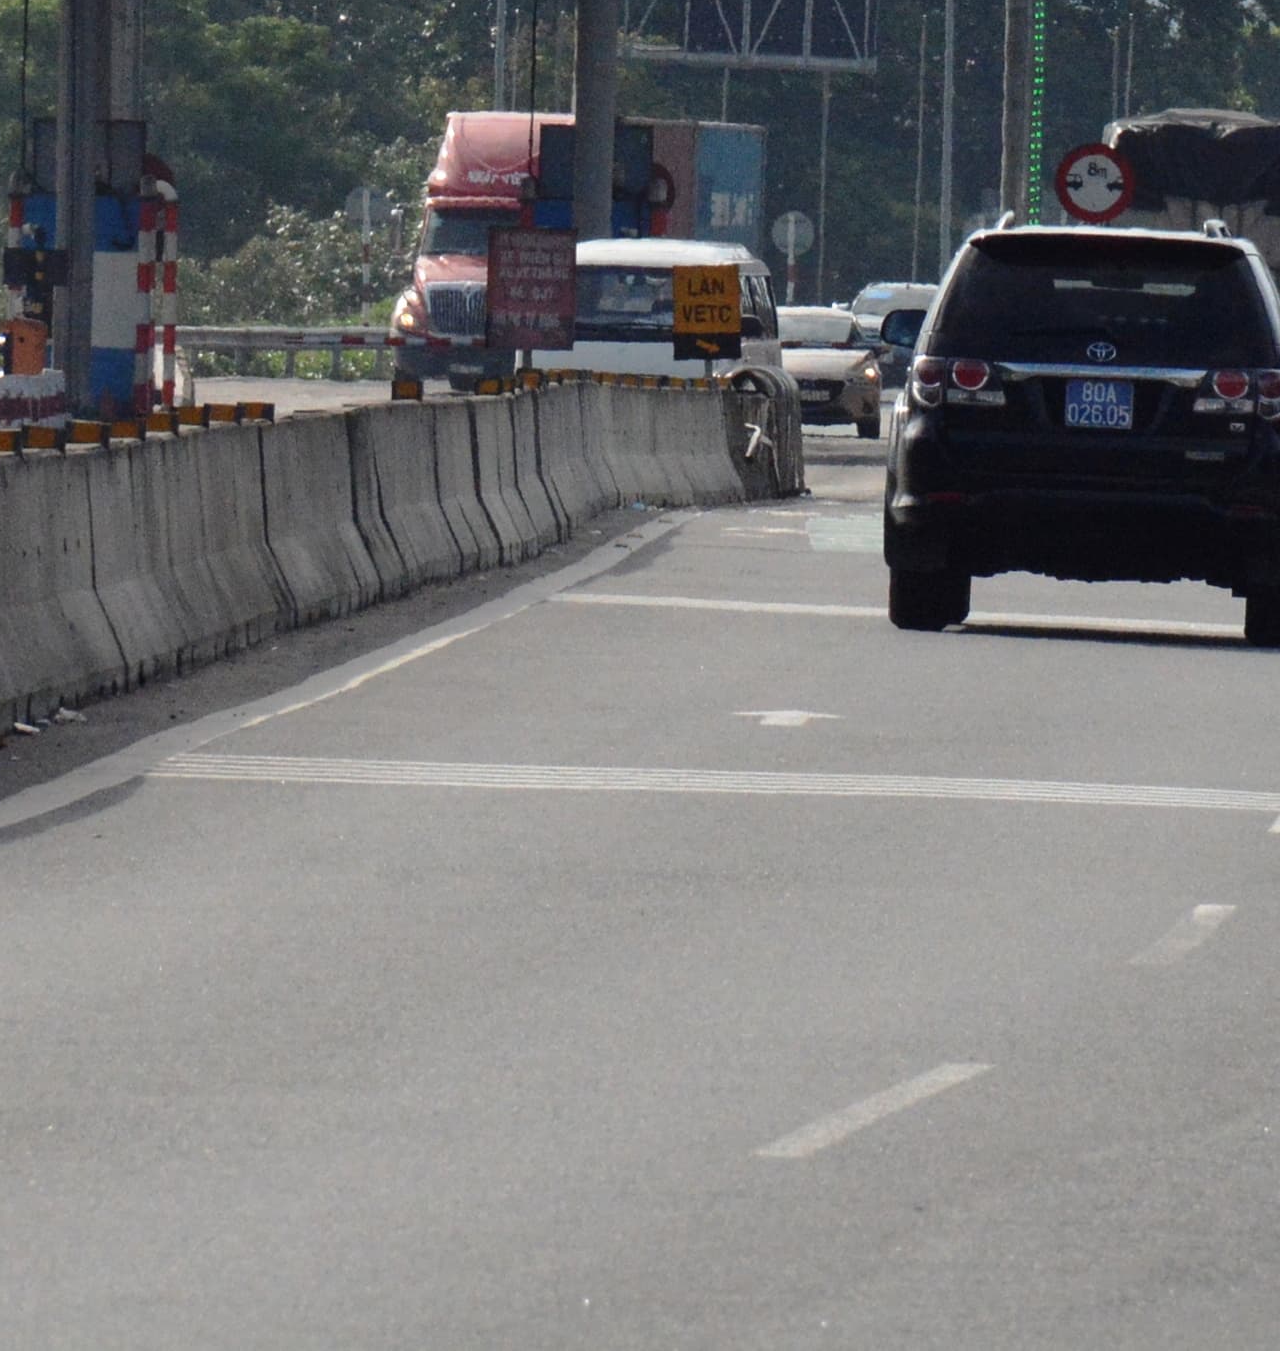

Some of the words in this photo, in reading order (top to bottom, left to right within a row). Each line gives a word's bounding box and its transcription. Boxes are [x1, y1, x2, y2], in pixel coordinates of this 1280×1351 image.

[682, 305, 732, 323] VETC
[1081, 385, 1118, 404] 80A
[1067, 404, 1131, 427] 026.05
